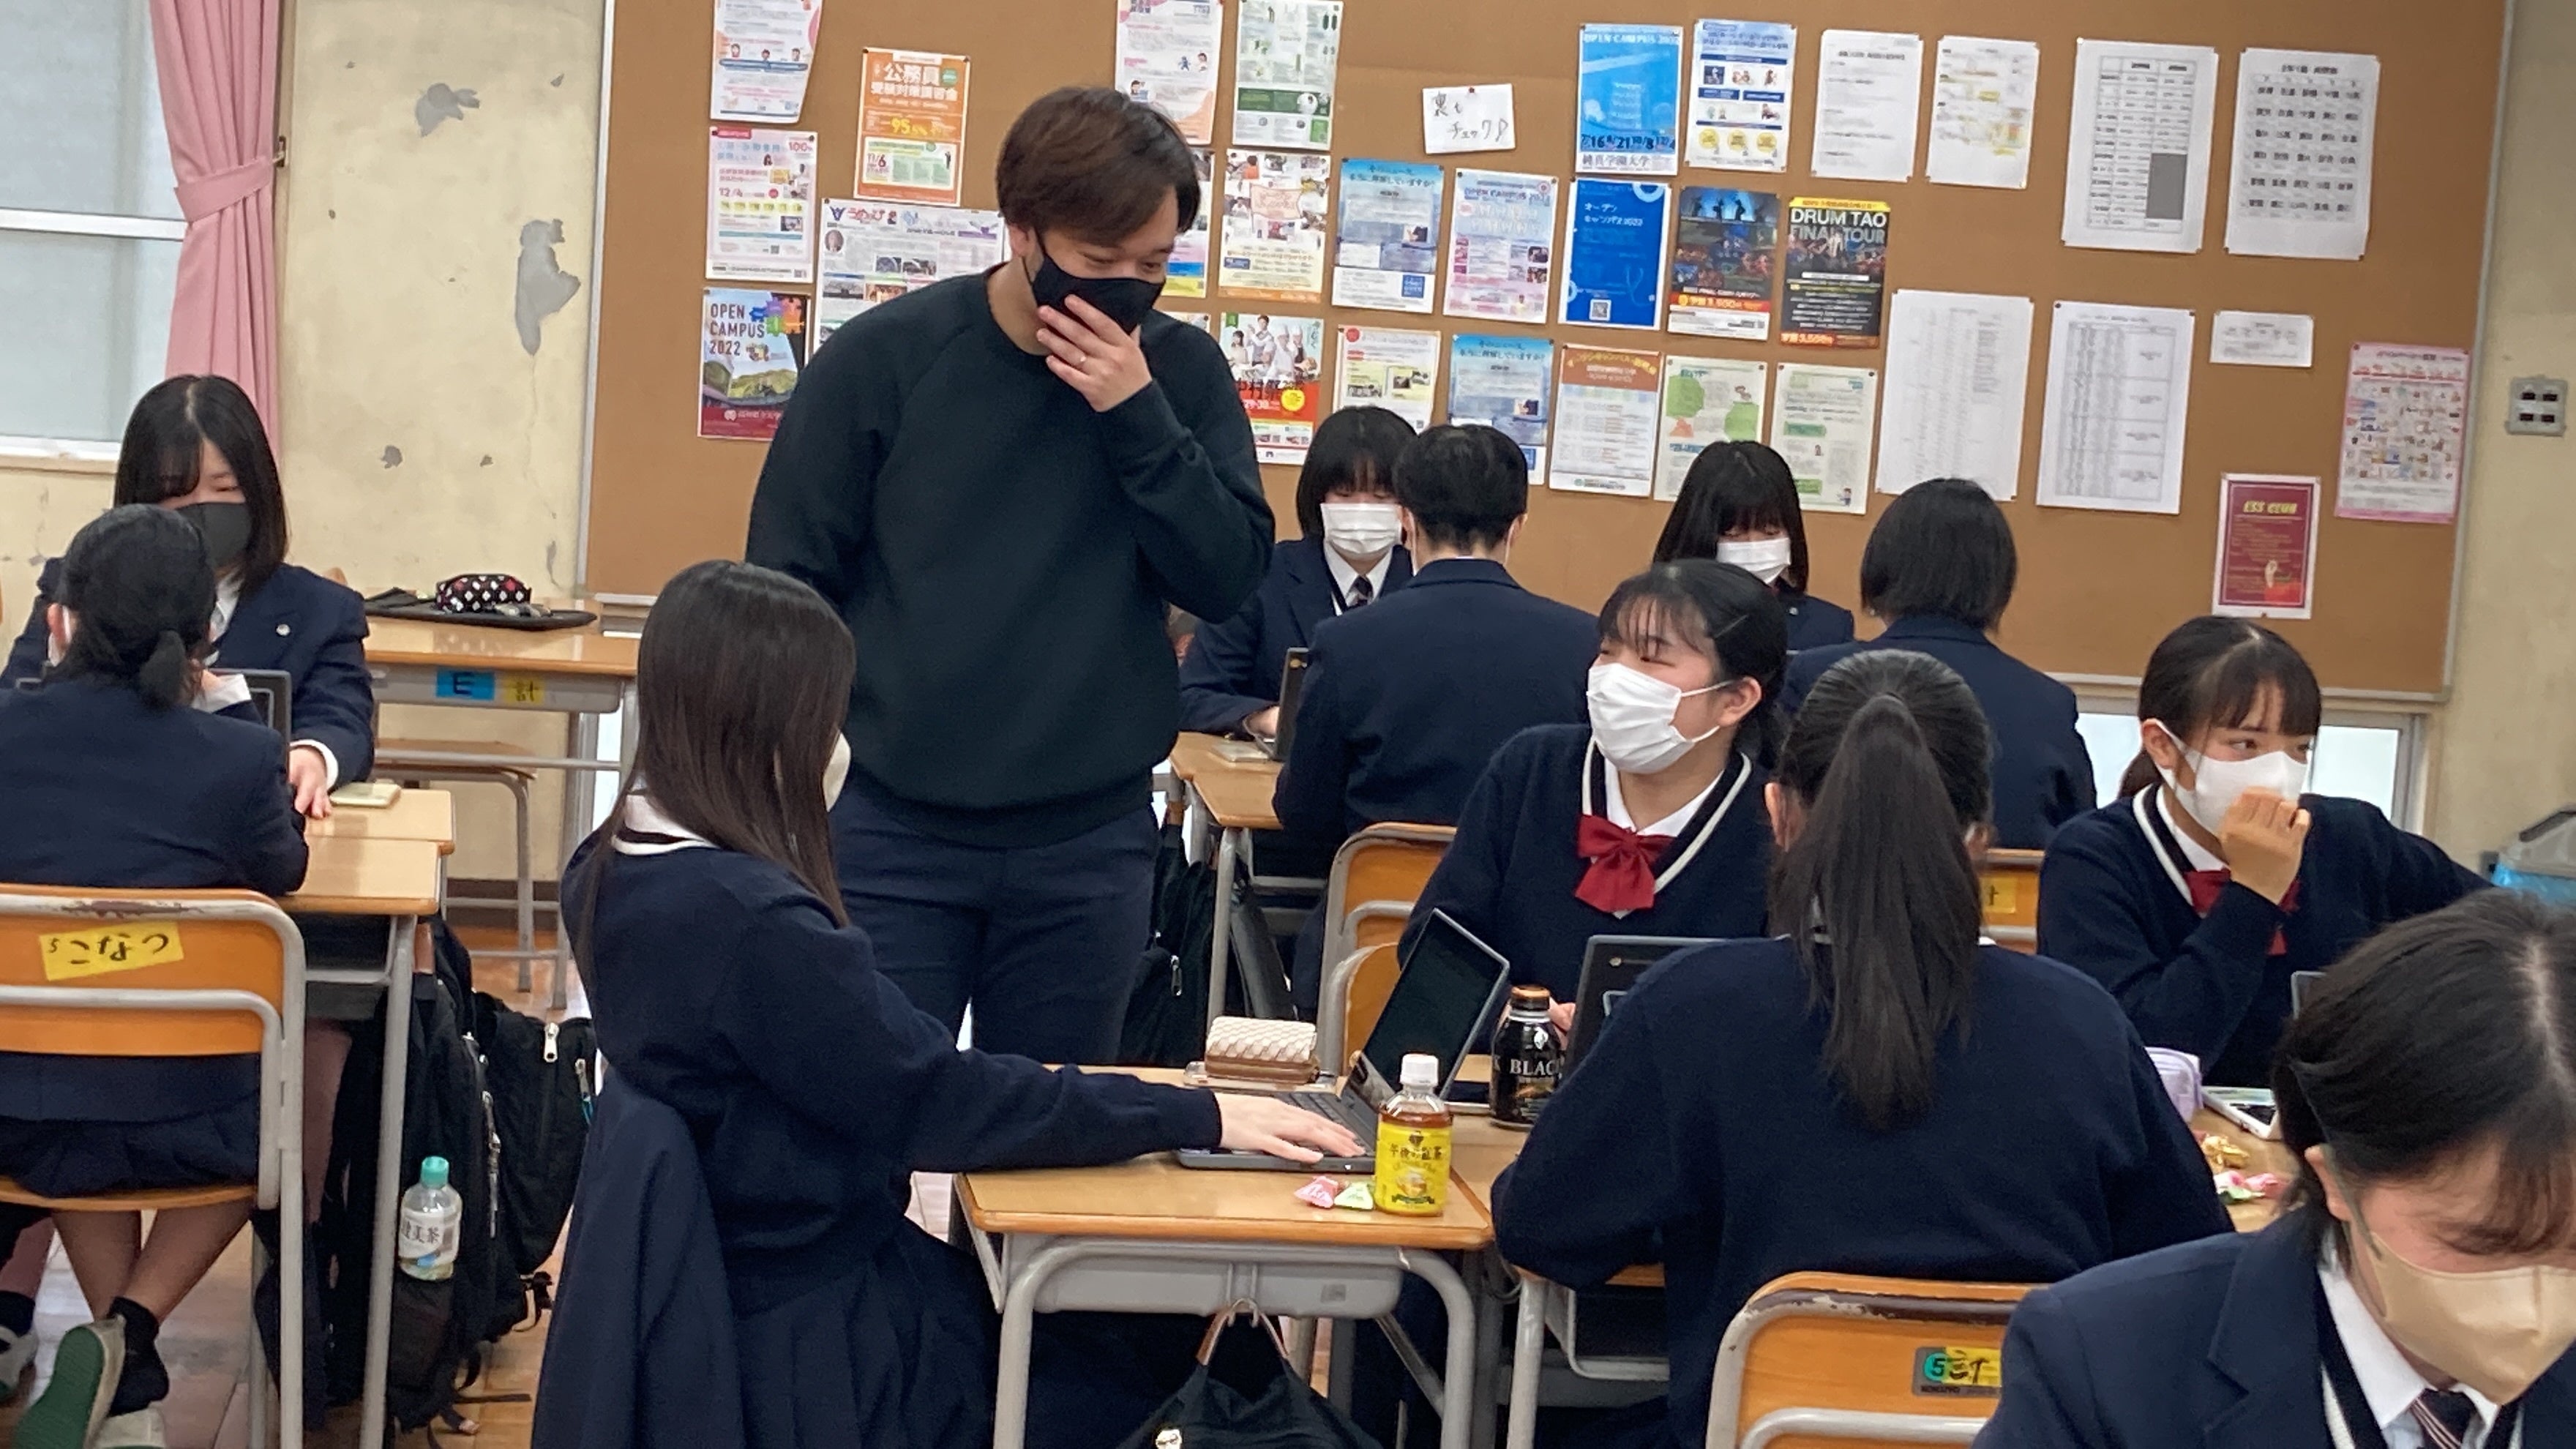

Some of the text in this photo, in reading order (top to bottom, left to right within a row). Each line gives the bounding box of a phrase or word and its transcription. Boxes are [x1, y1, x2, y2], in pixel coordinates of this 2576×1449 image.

[1790, 208, 1887, 228] DRUM TAO
[1843, 227, 1885, 244] TOUR
[710, 303, 745, 319] OPEN
[709, 321, 765, 339] CAMPUS
[709, 340, 741, 356] 2022
[452, 670, 474, 695] E
[1510, 1058, 1563, 1079] BLAC
